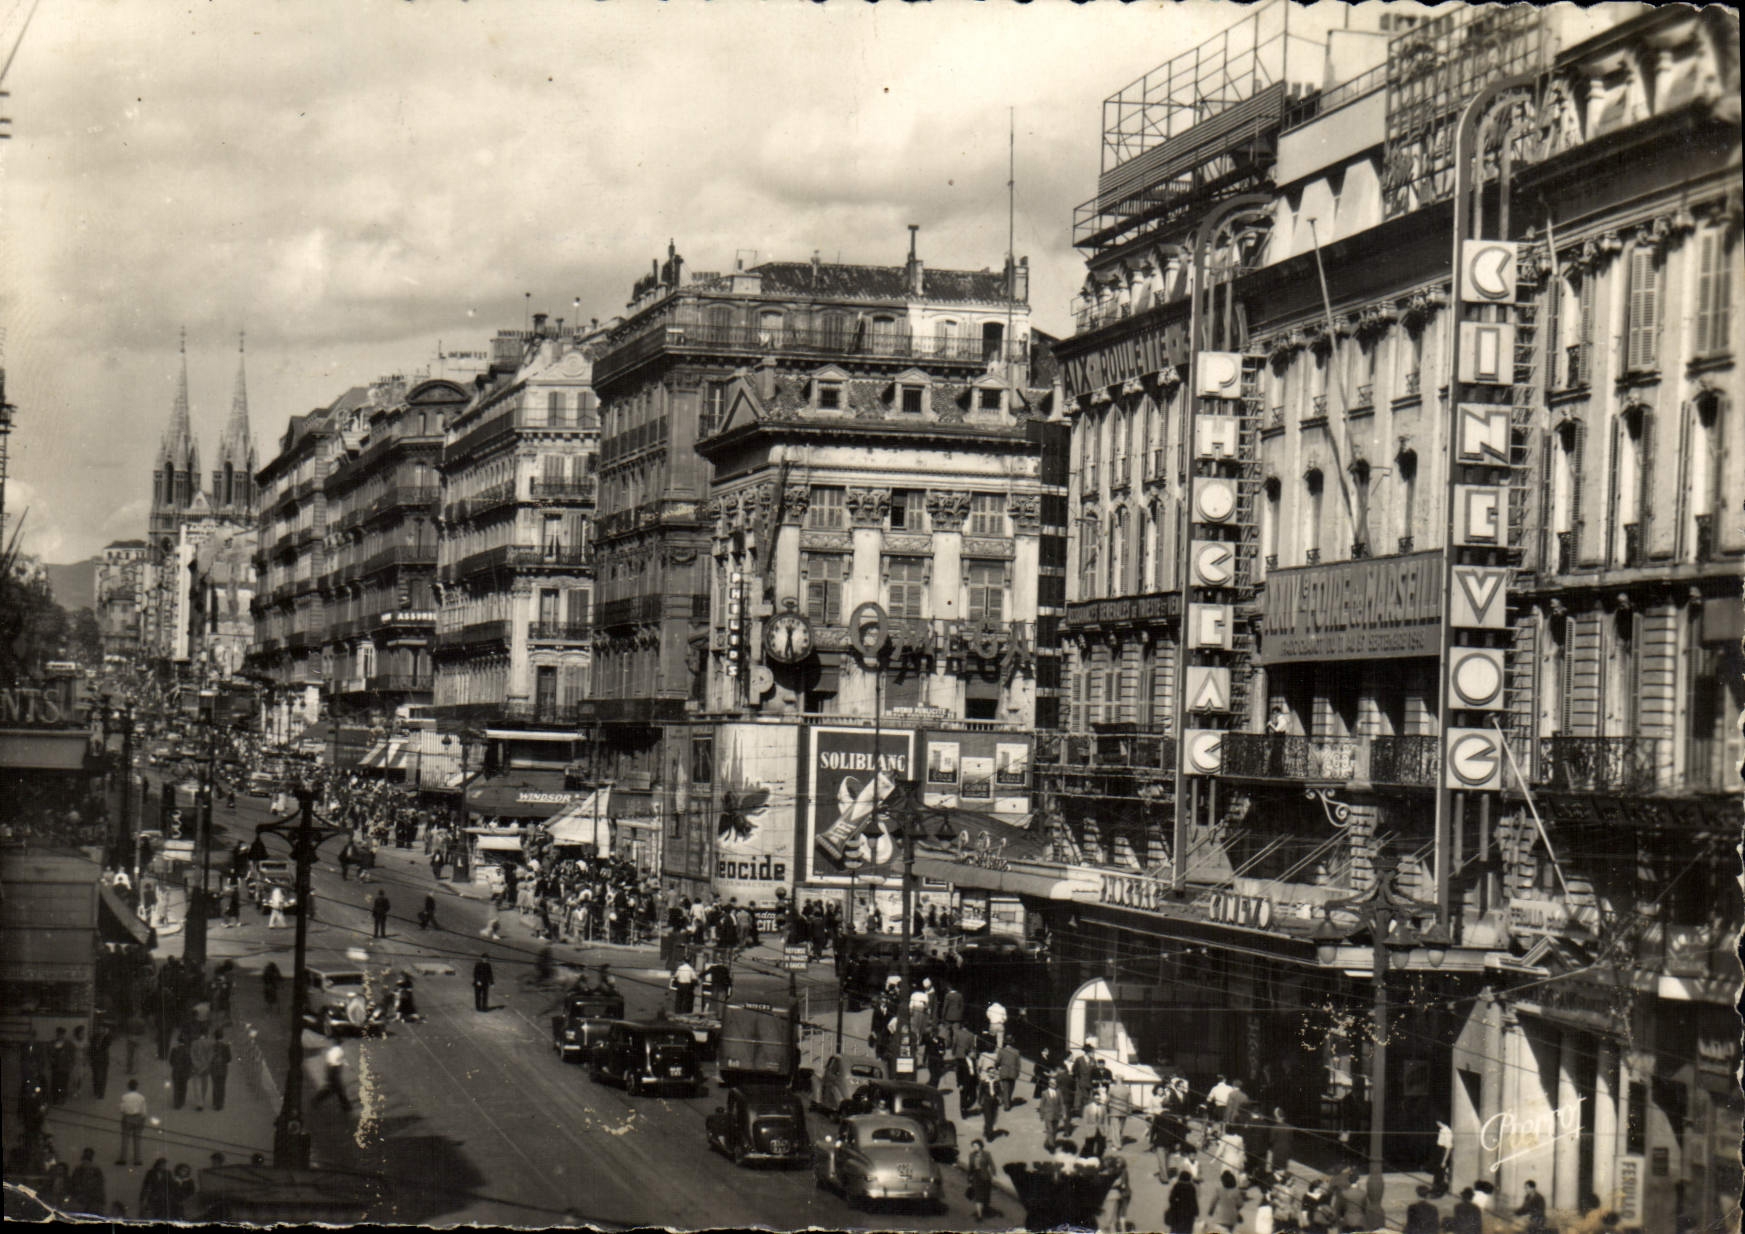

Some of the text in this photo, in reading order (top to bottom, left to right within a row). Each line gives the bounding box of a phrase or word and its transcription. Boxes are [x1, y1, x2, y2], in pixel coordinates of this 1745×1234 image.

[1361, 558, 1442, 631] MARSEILL
[820, 752, 906, 772] SOLIBLANC
[518, 792, 572, 802] WINDSOR
